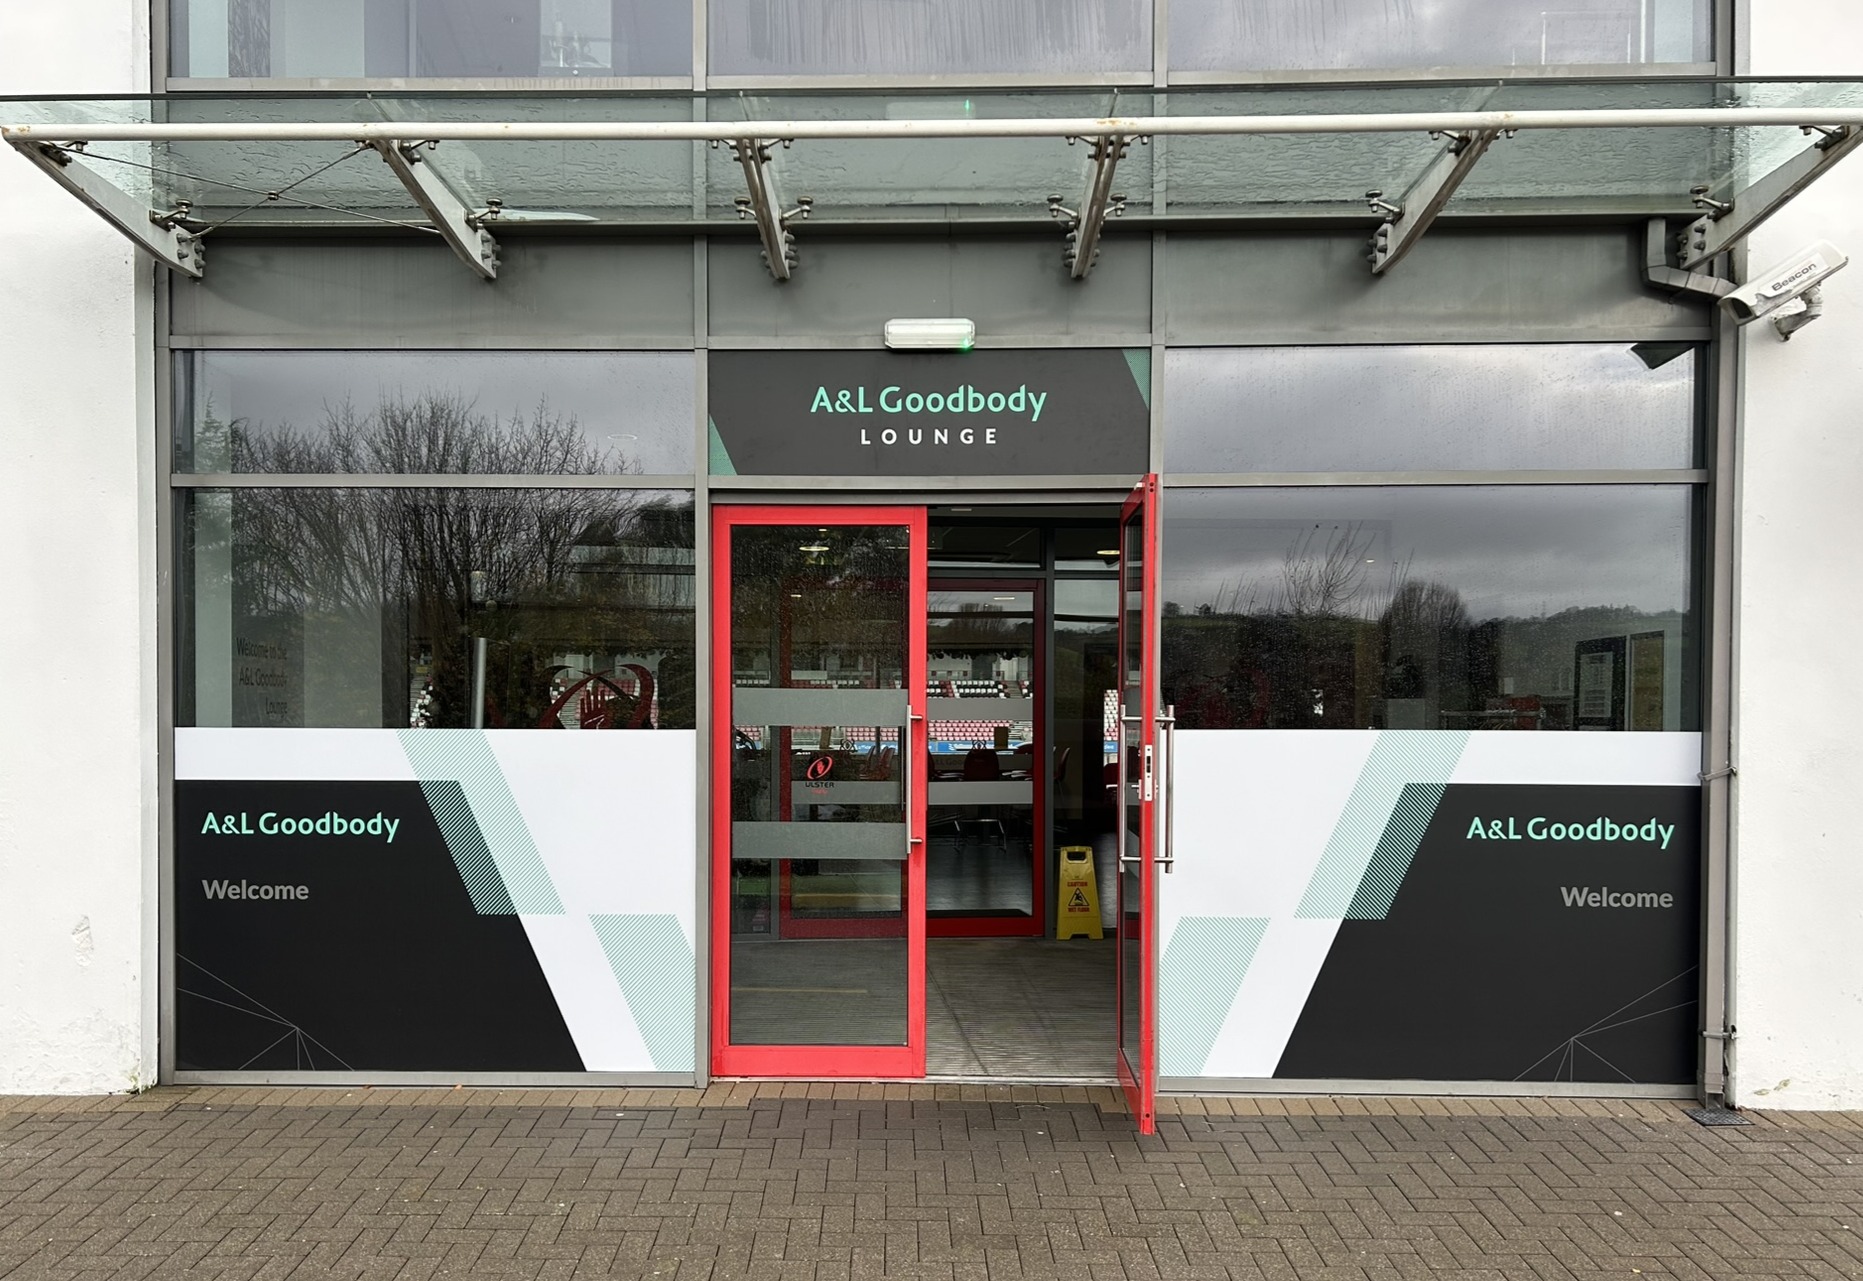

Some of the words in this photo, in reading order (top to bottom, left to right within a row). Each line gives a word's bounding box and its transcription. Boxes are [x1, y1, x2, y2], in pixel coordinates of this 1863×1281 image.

[1771, 263, 1818, 292] Beacon
[810, 386, 873, 413] A&L
[879, 384, 1047, 422] Goodbody
[860, 428, 997, 445] LOUNGE
[236, 637, 269, 659] Welcome
[201, 811, 255, 835] A&L
[259, 811, 400, 843] Goodbody
[1466, 816, 1522, 840] A&L
[1527, 816, 1675, 850] Goodbody
[202, 879, 309, 900] Welcome
[1560, 886, 1673, 908] Welcome
